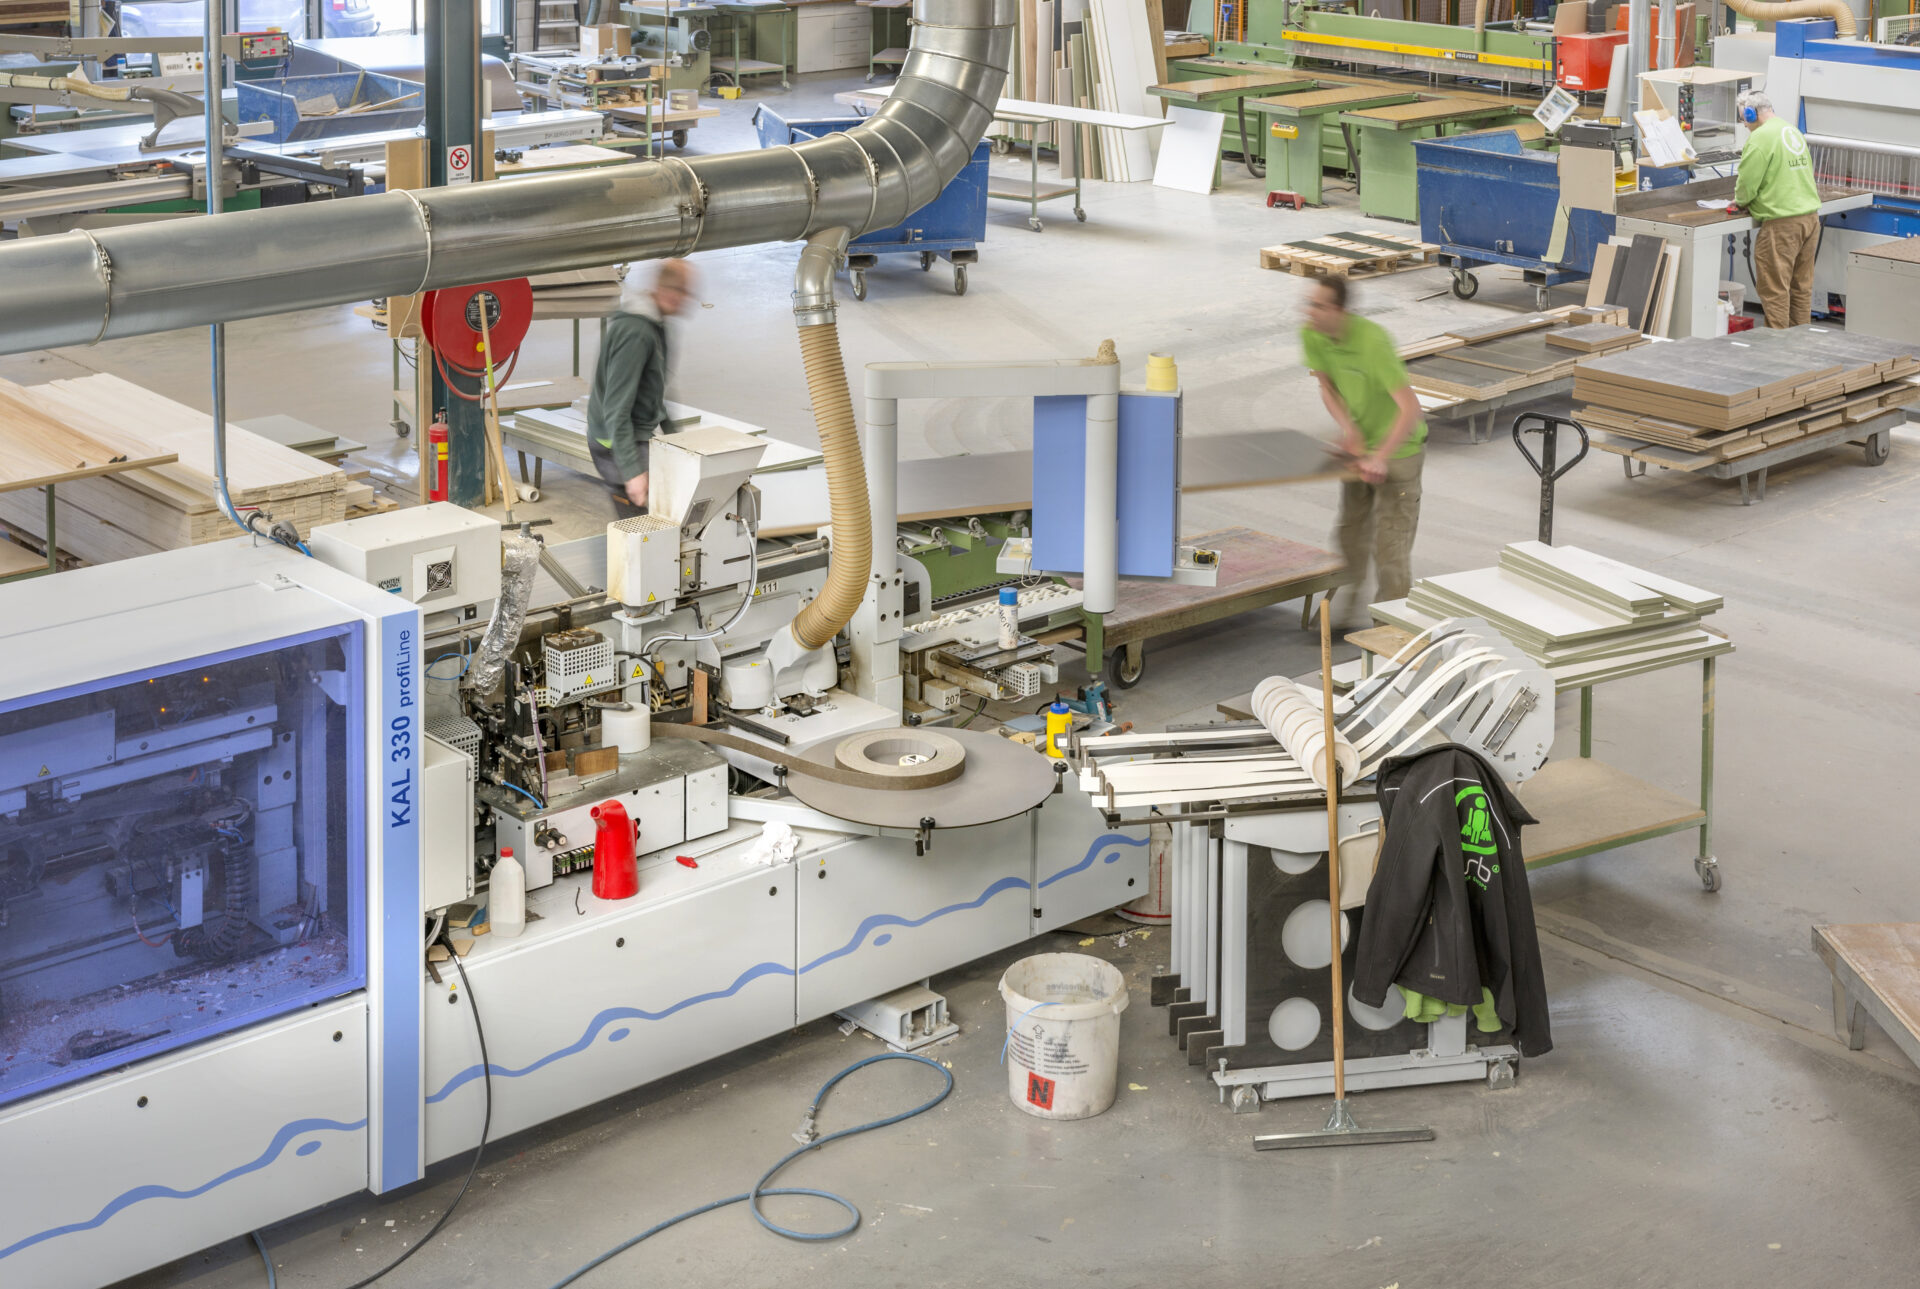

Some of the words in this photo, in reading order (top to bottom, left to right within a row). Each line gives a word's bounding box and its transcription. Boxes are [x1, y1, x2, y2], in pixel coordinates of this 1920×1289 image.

[762, 581, 777, 593] 111
[397, 630, 413, 708] profiLine
[944, 693, 960, 706] 207
[391, 715, 411, 763] 330
[391, 768, 411, 829] KAL
[1030, 1079, 1050, 1105] N
